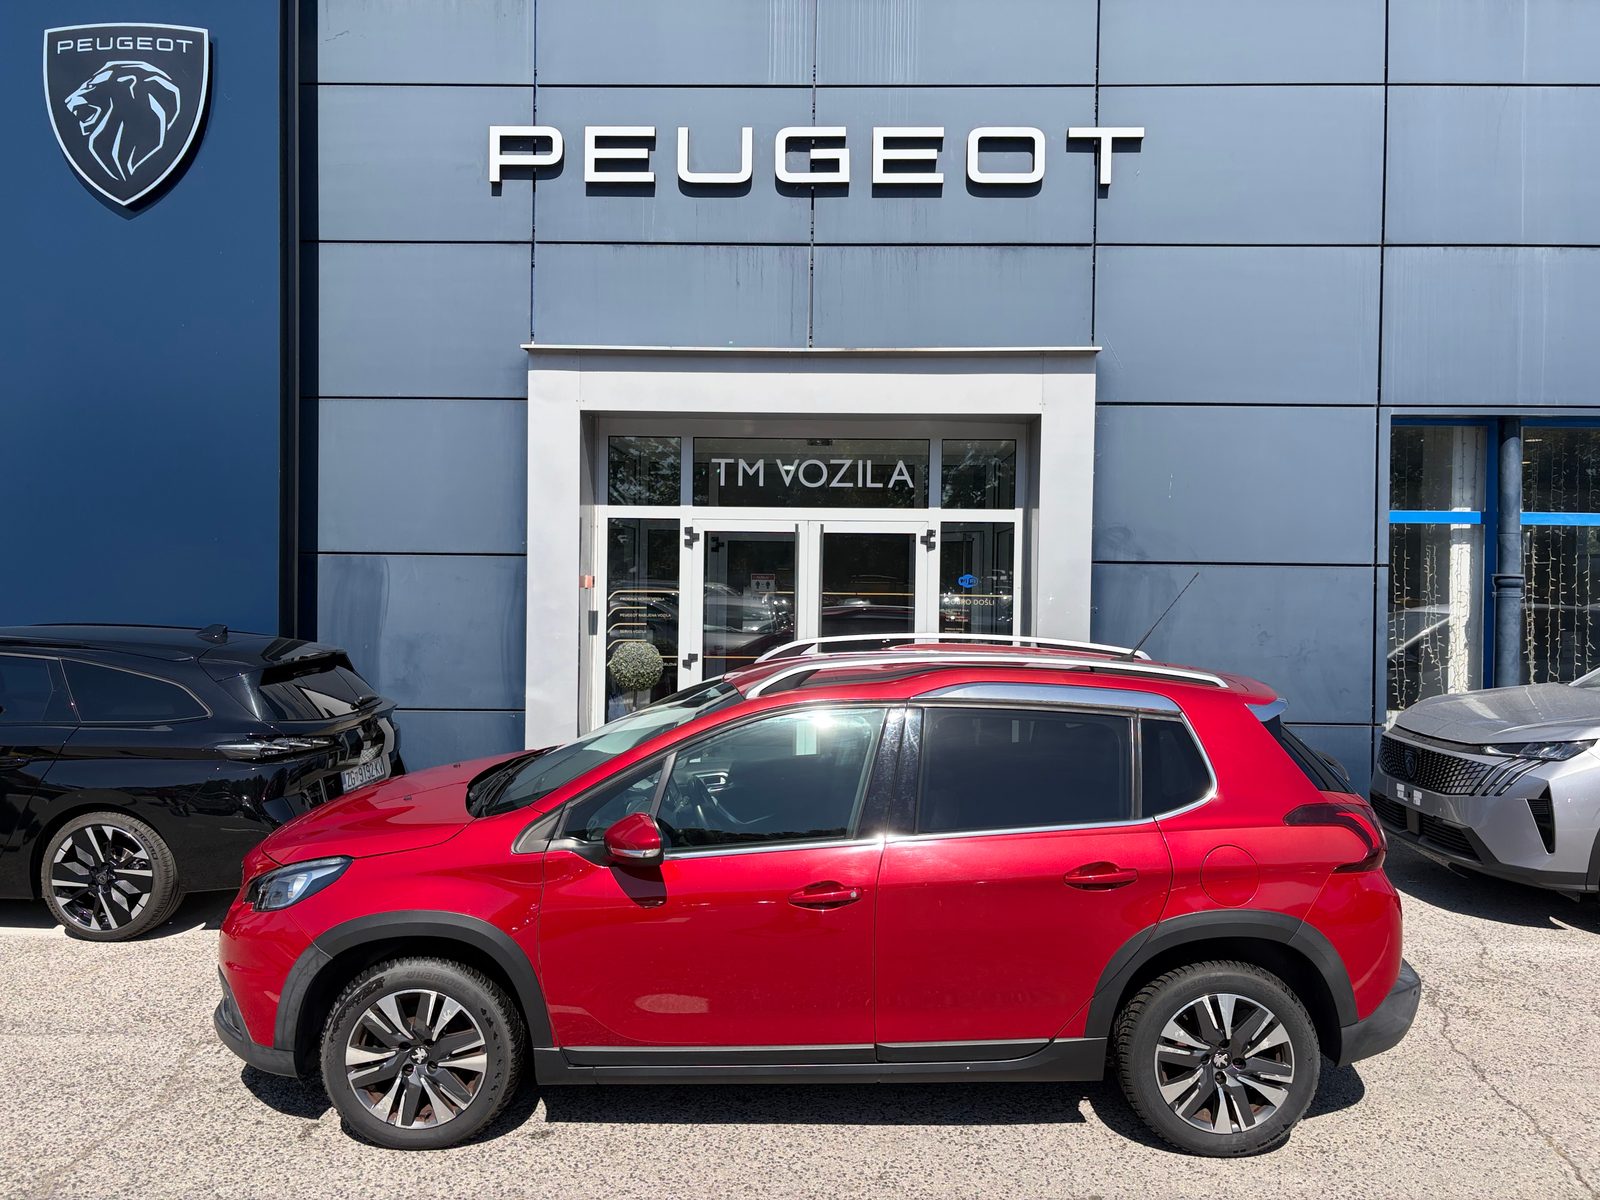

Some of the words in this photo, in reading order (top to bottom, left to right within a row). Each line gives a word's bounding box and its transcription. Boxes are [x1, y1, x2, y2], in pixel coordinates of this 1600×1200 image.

[57, 37, 193, 54] PEUGEOT
[489, 125, 1145, 185] PEUGEOT
[711, 458, 764, 487] TM
[776, 458, 914, 488] VOZILA
[973, 598, 995, 606] DOŠLI
